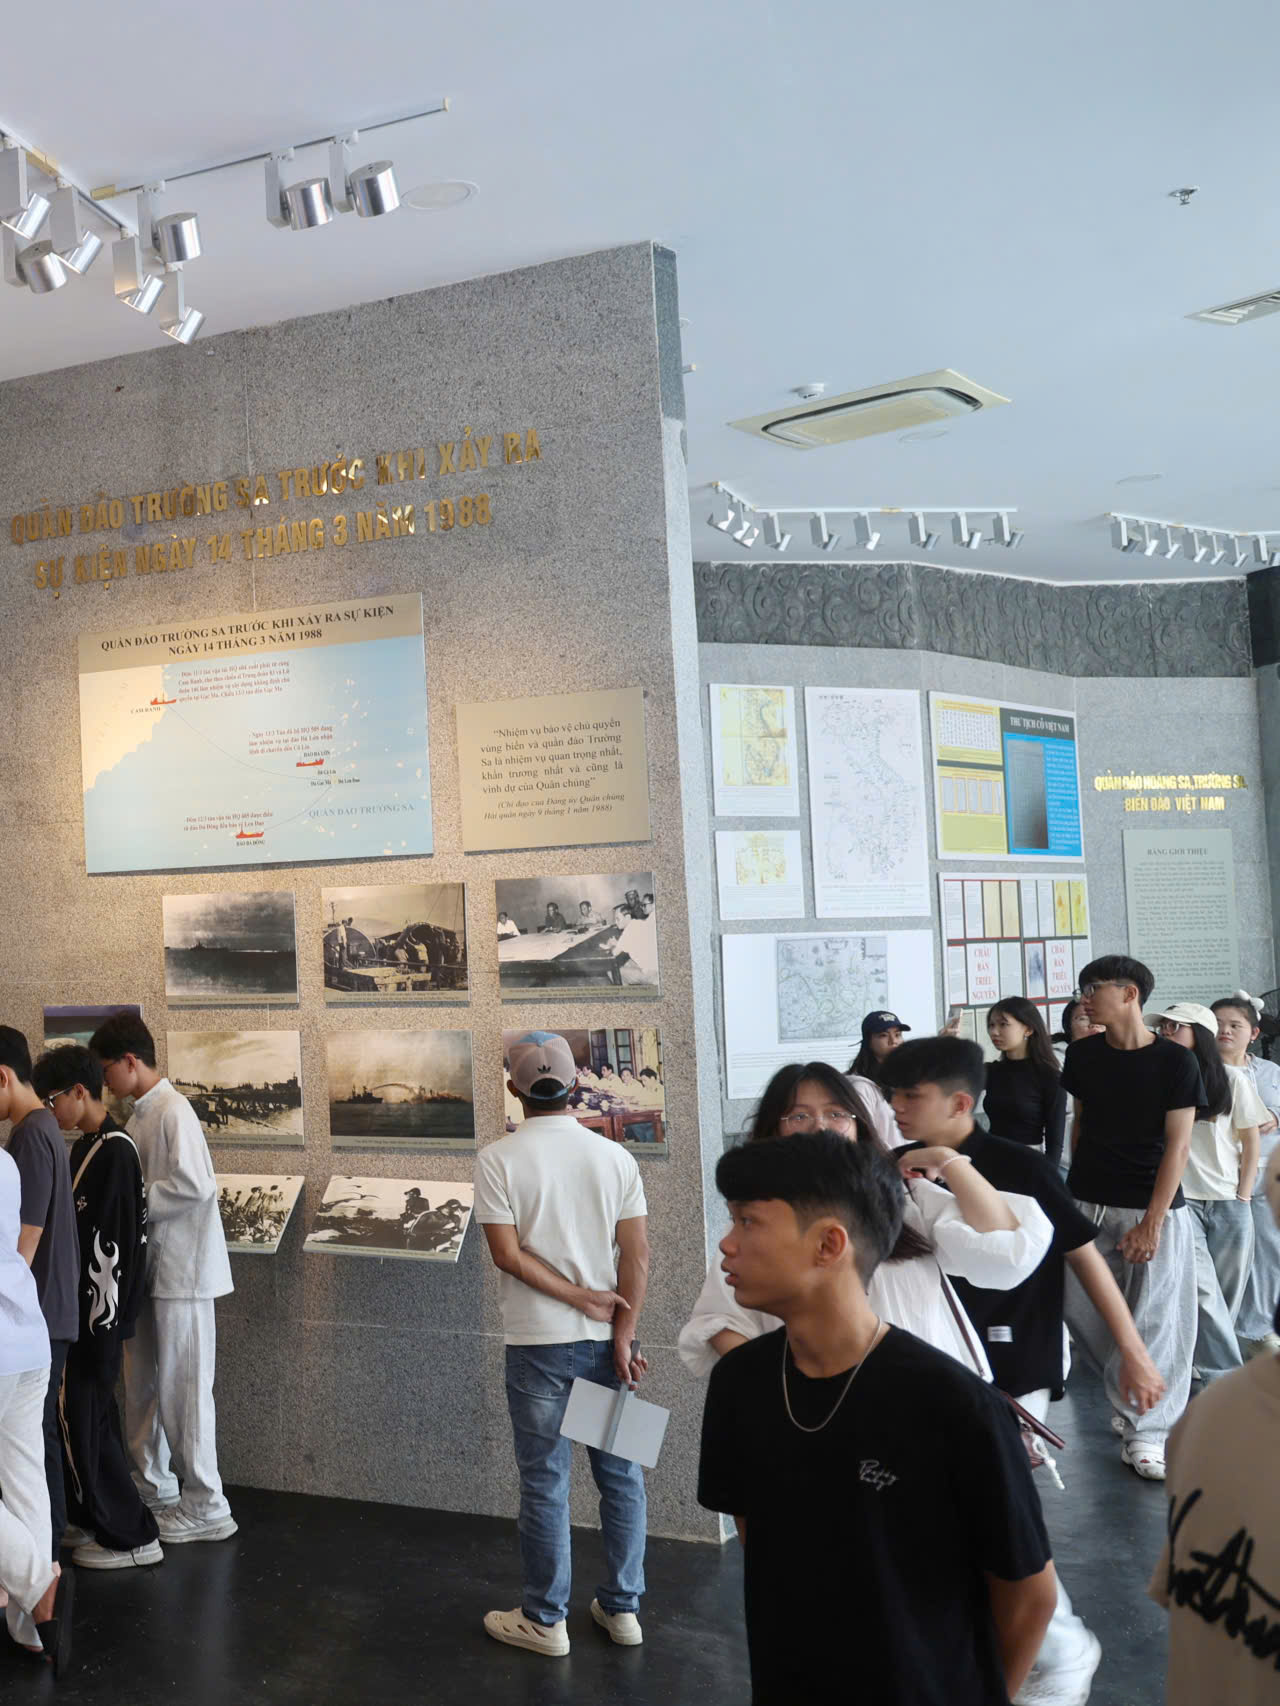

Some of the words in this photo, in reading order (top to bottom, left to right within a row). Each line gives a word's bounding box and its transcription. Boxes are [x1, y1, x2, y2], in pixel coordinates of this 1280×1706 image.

[11, 497, 72, 544] QUẦN
[80, 491, 124, 533] ĐẢO
[129, 480, 228, 525] TRƯỜNG
[234, 474, 270, 506] SA
[279, 453, 365, 500] TRƯỚC
[376, 448, 425, 486] KHI
[439, 425, 492, 475] XẢY
[504, 428, 544, 464] RA
[35, 556, 64, 599] SỰ
[75, 544, 127, 590] KIỆN
[135, 534, 196, 576] NGÀY
[207, 534, 232, 564] 14
[241, 516, 324, 561] THÁNG
[333, 515, 348, 546] 3
[356, 500, 415, 543] NĂM
[423, 493, 492, 533] 1988
[135, 630, 158, 647] ĐẢO
[161, 626, 209, 644] TRƯỜNG
[211, 626, 226, 638] SA
[228, 619, 270, 635] TRƯỚC
[272, 616, 294, 630] KHI
[297, 611, 323, 626] XẢY
[325, 612, 342, 624] RA
[344, 608, 362, 623] SỰ
[363, 605, 395, 619] KIỆN
[169, 641, 200, 657] NGÀY
[203, 641, 214, 652] 14
[217, 635, 257, 650] THÁNG
[259, 634, 266, 645] 3
[269, 628, 295, 644] NĂM
[299, 629, 323, 641] 1988
